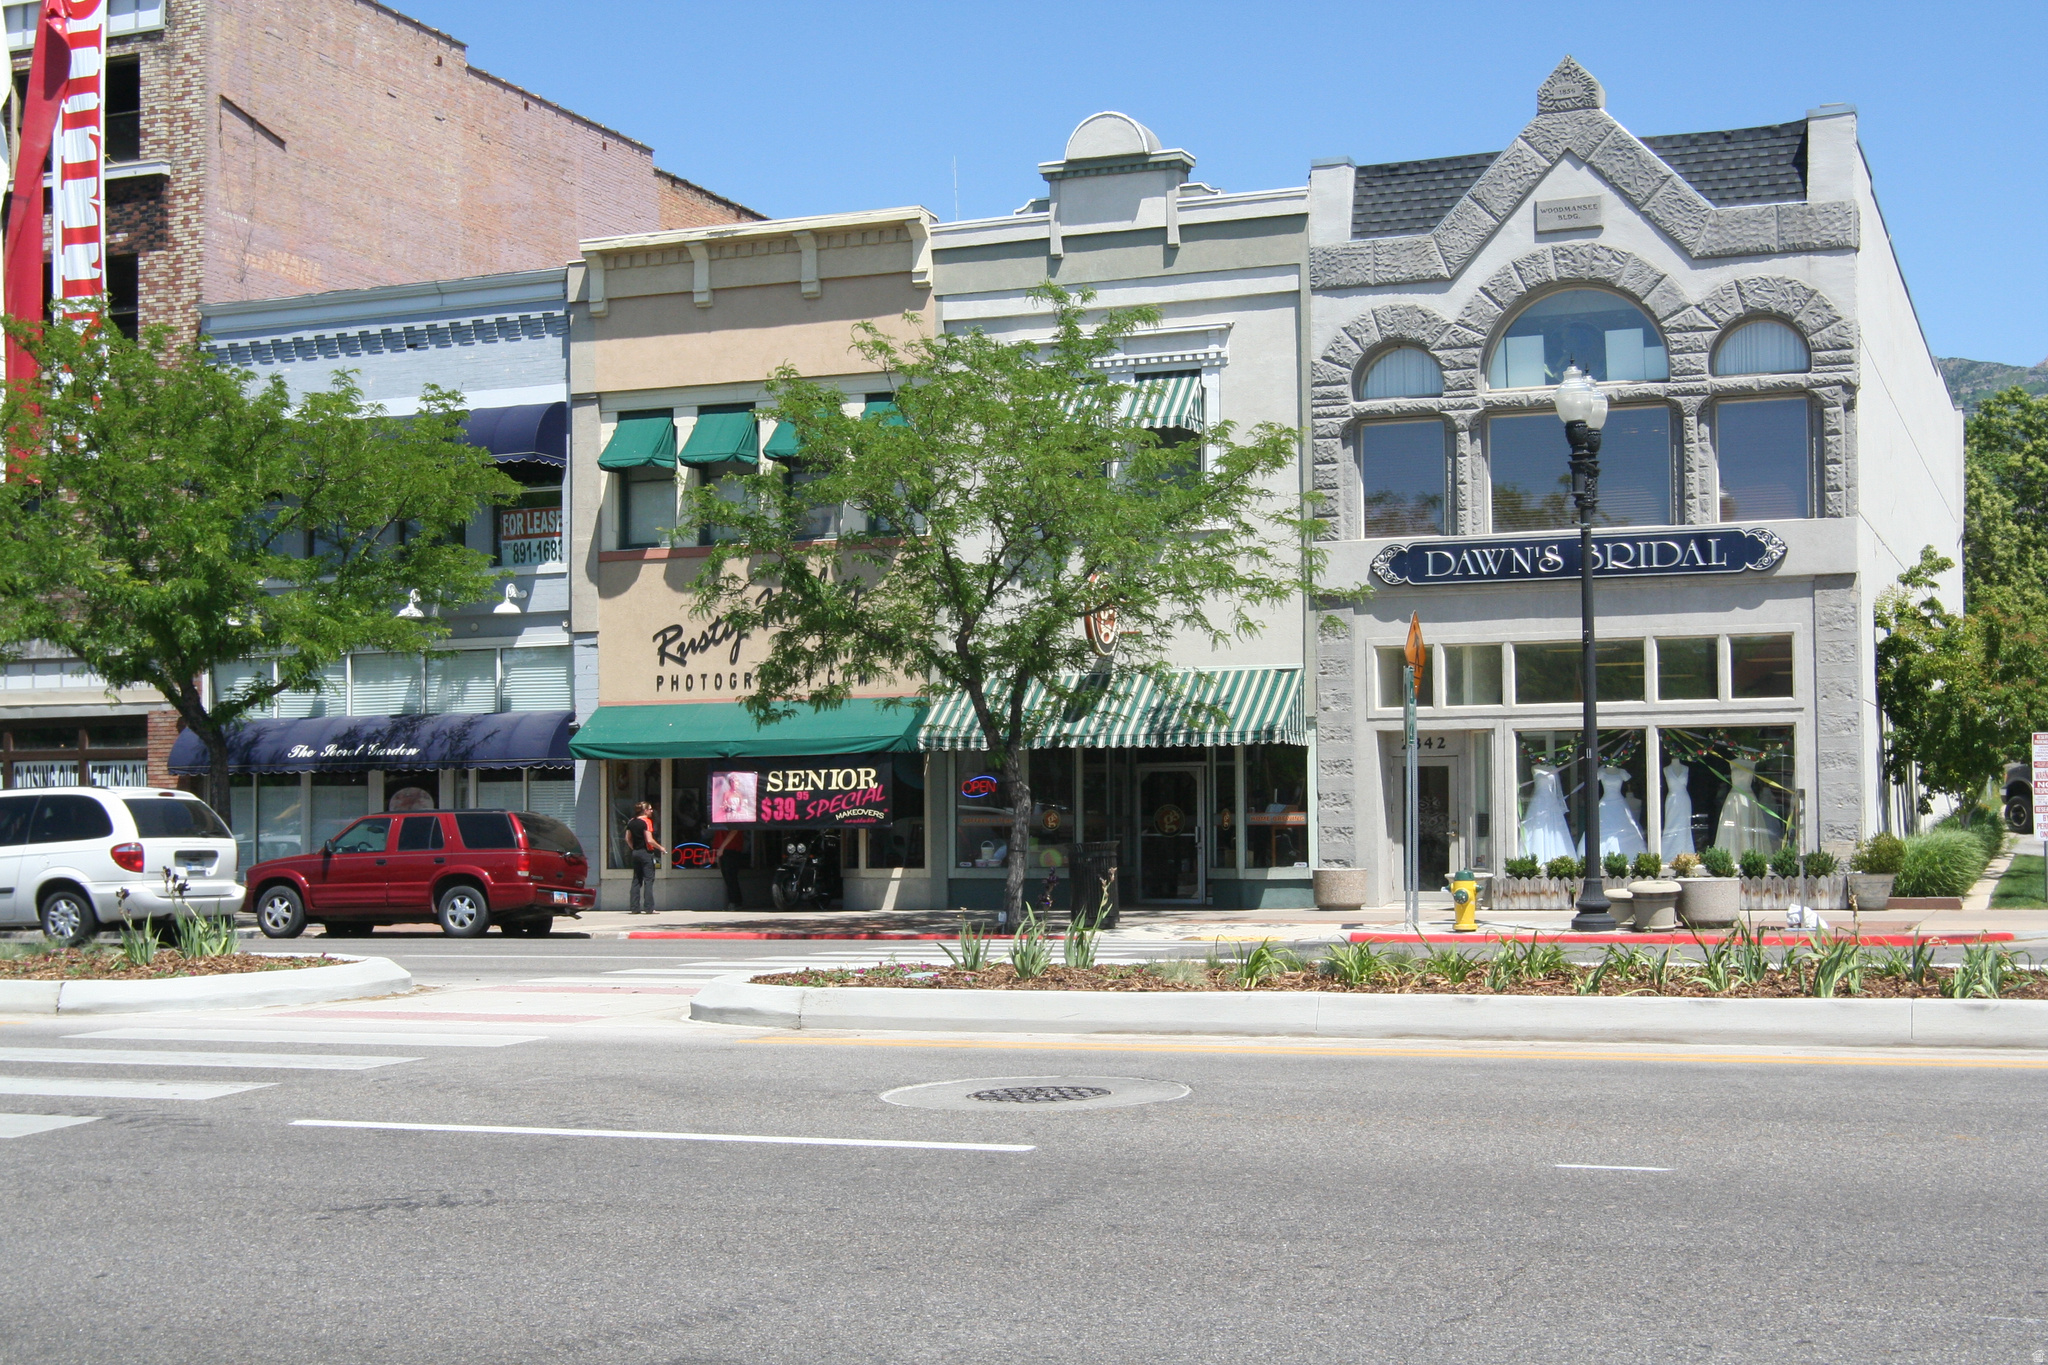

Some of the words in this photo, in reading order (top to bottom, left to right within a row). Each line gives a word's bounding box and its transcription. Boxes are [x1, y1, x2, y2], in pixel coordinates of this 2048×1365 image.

[1540, 203, 1598, 214] WOODMANSEE
[1557, 213, 1581, 221] BLDG.
[502, 513, 525, 536] FOR
[526, 510, 563, 535] LEASE
[1424, 544, 1565, 578] DAWN'S
[1578, 538, 1727, 571] BRIDAL
[653, 615, 749, 668] Rusty
[287, 744, 317, 759] The
[320, 743, 365, 758] Secret
[367, 742, 420, 757] Garden
[132, 764, 148, 787] OU
[766, 767, 879, 792] SENIOR
[961, 780, 997, 794] OPEN
[805, 784, 887, 820] SPECIAL
[835, 808, 885, 821] MAKEOVERS
[671, 847, 717, 866] OPEN
